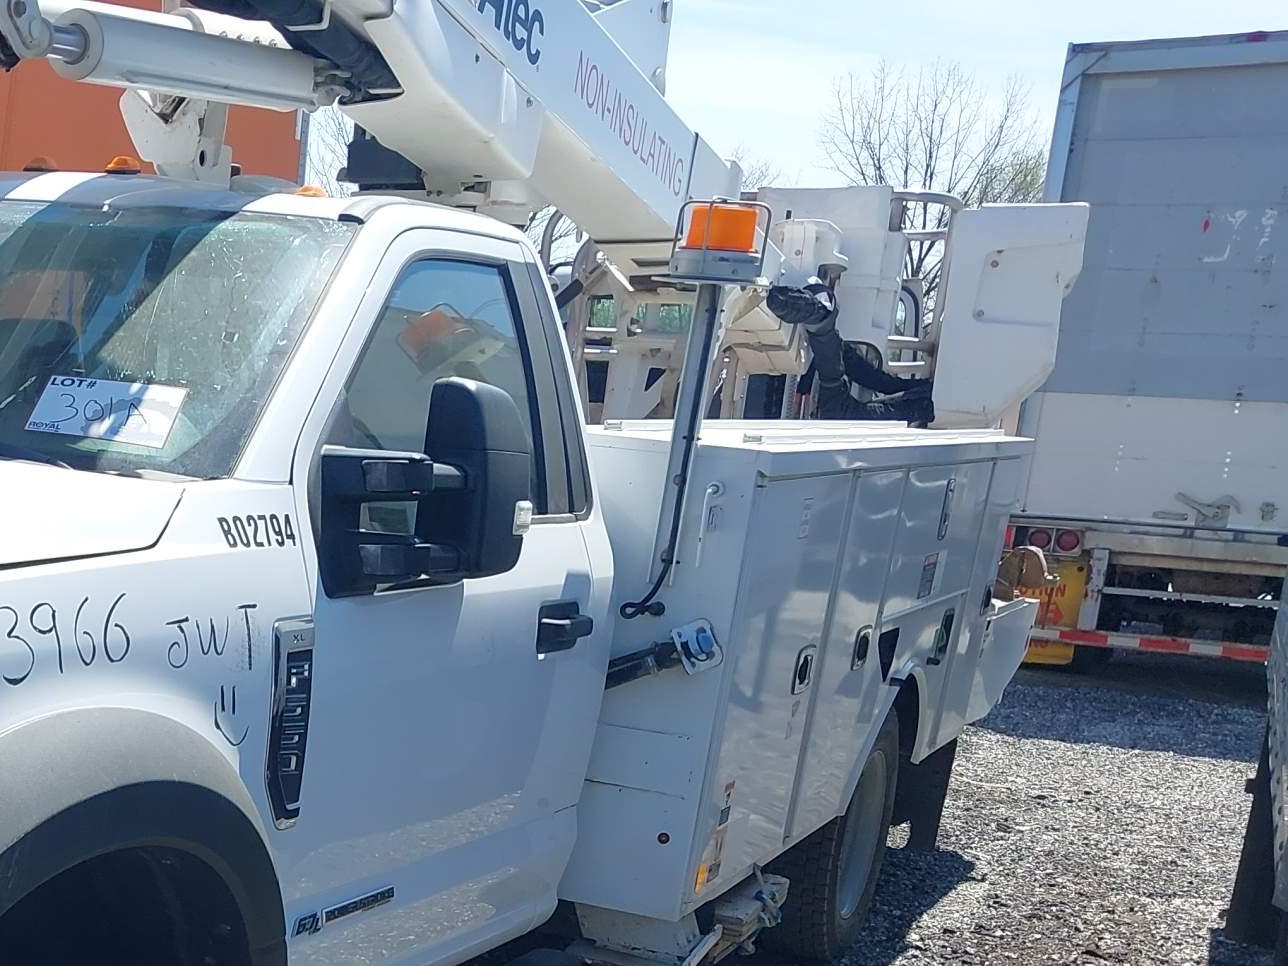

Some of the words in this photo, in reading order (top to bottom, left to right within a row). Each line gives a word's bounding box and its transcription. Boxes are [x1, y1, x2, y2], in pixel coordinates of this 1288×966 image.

[574, 50, 684, 196] NON-INSULATING
[50, 377, 98, 389] LOT#
[28, 420, 61, 431] ROYAL
[50, 393, 147, 427] 301A
[165, 603, 258, 672] JWT
